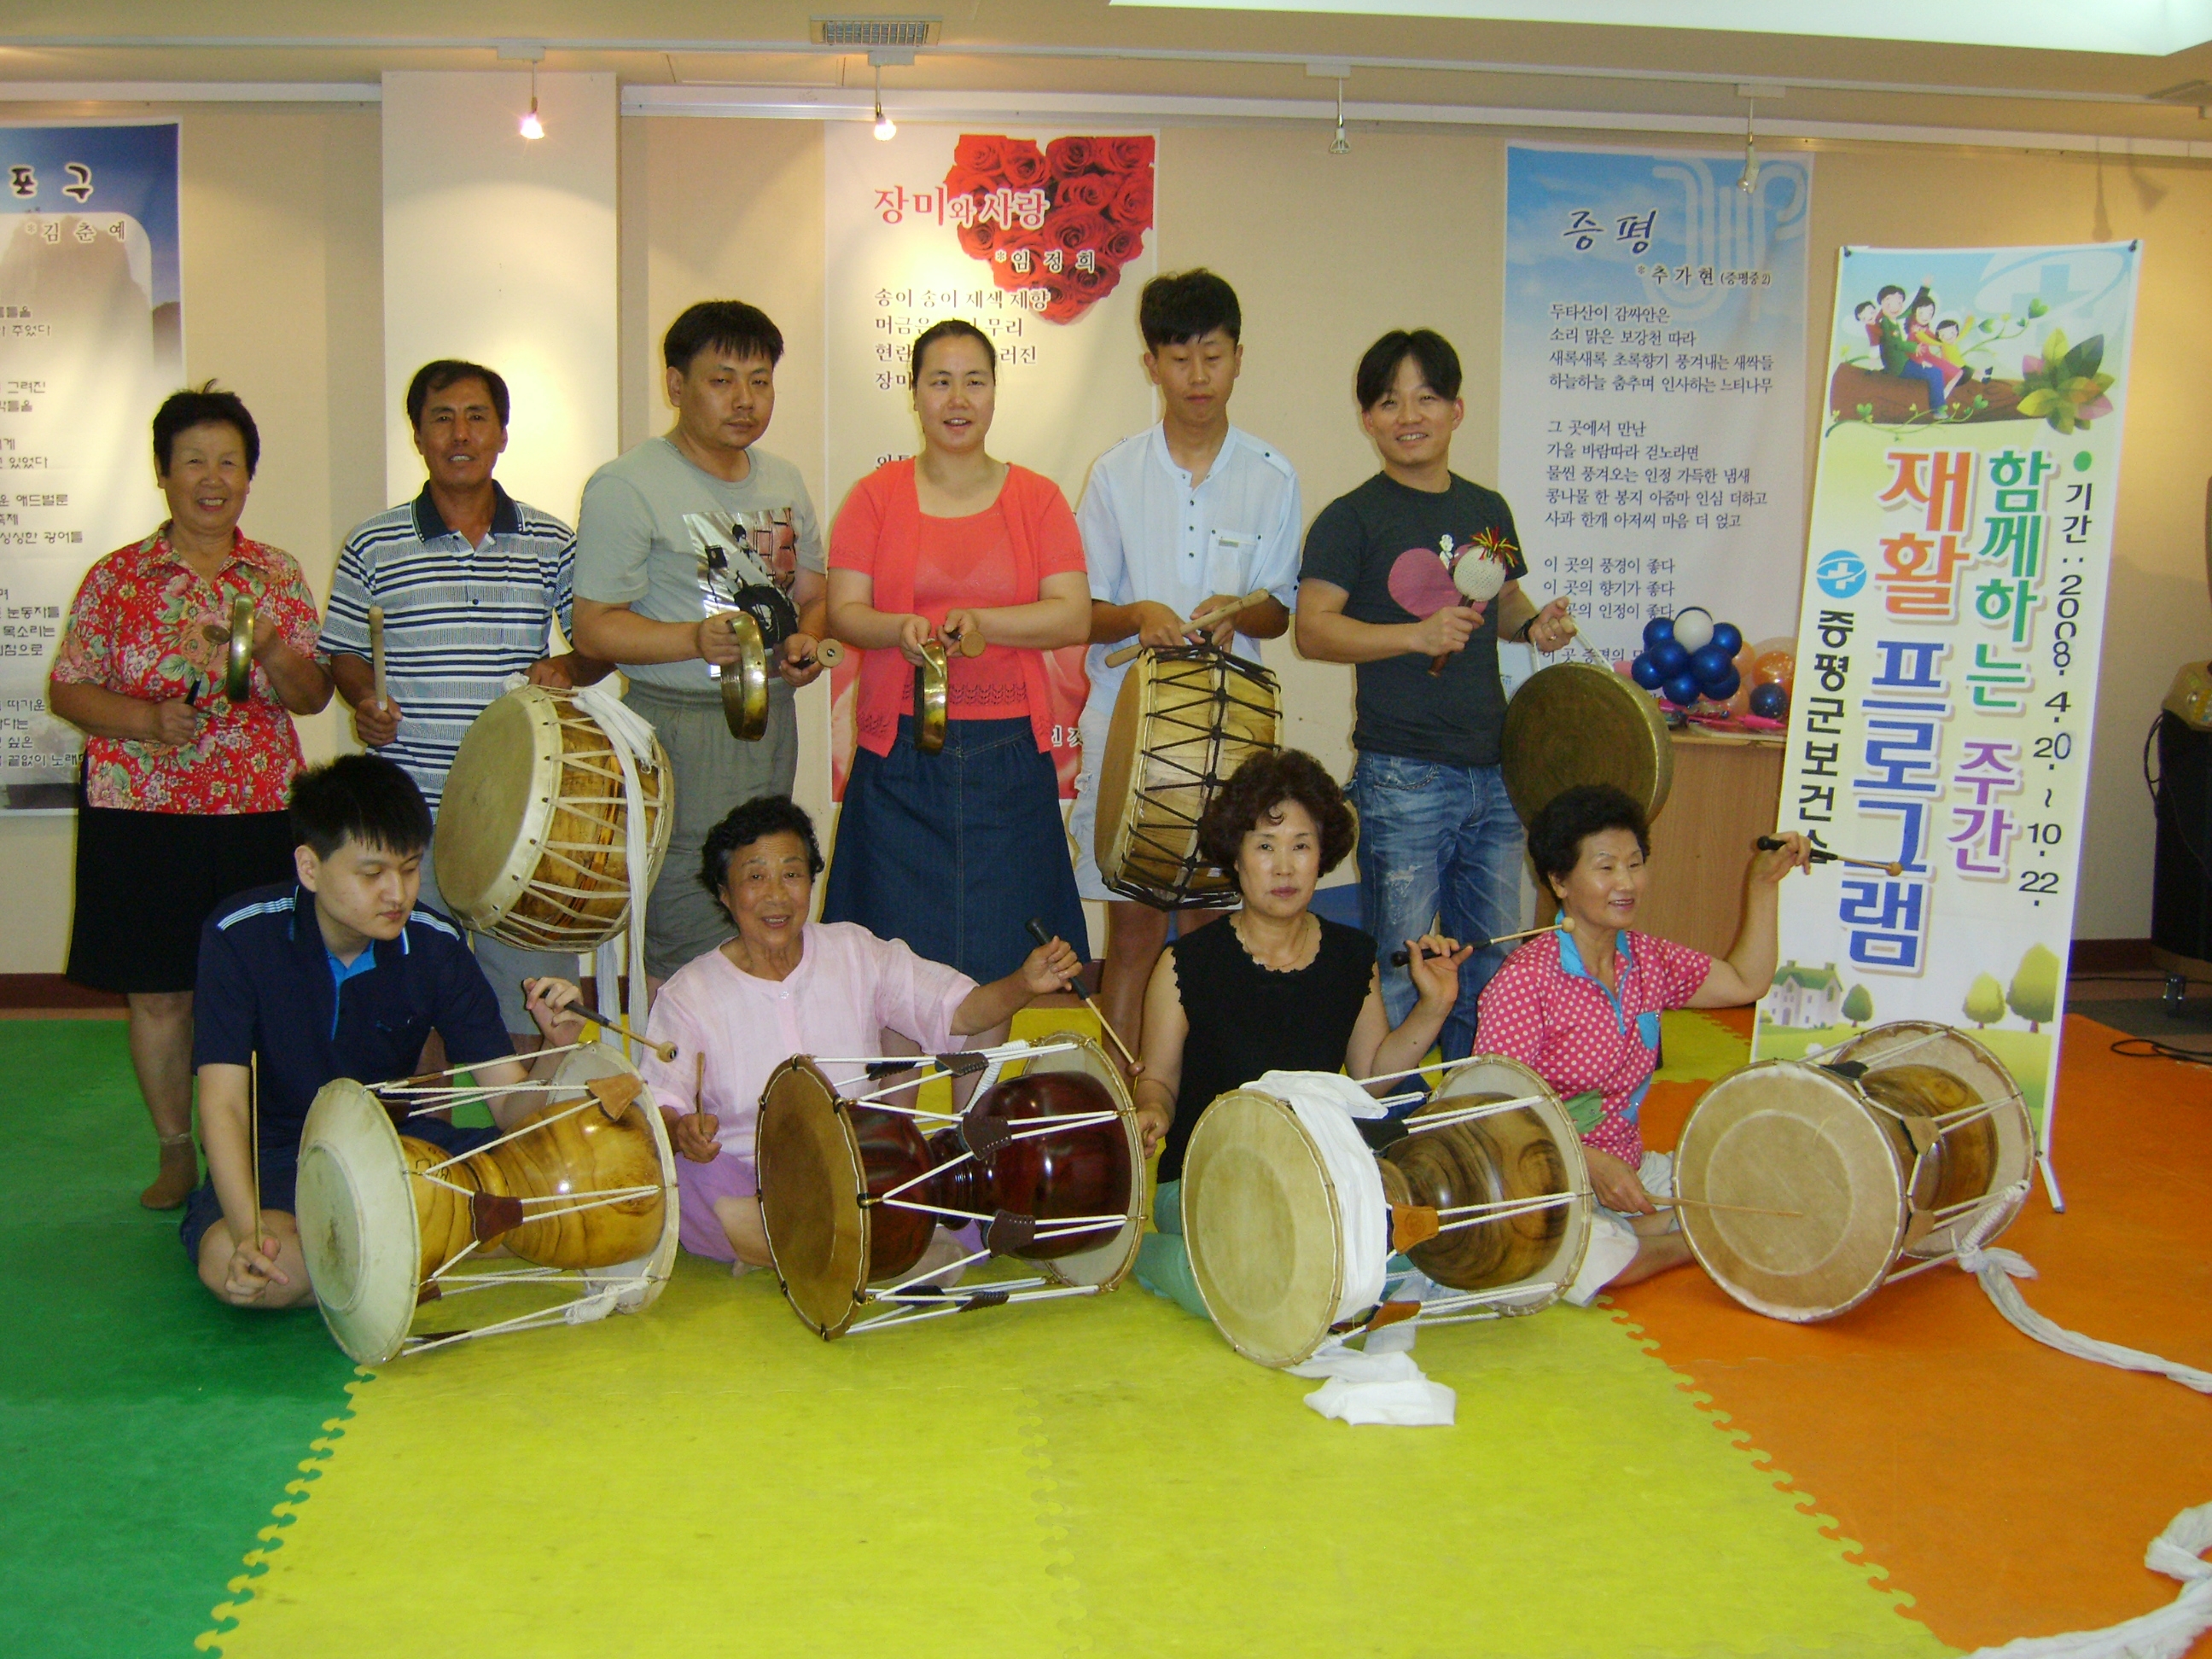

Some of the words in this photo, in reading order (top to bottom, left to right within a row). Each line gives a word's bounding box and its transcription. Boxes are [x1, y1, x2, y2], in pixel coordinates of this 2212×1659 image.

[875, 185, 974, 226] 장미와
[982, 191, 1048, 226] 사랑
[875, 288, 912, 307] 송이
[921, 289, 957, 308] 송이
[1550, 304, 1608, 322] 두타산이
[1614, 306, 1670, 324] 감싸안은
[12, 325, 51, 337] 주었다
[1550, 328, 1579, 344] 소리
[1585, 329, 1615, 345] 맑은
[1621, 329, 1662, 346] 보강천
[1668, 330, 1697, 347] 따라
[999, 346, 1037, 365] 러진
[1613, 352, 1668, 370] 초록향기
[8, 381, 45, 393] 그려진
[1549, 373, 1607, 391] 하늘하늘
[1662, 375, 1715, 393] 인사하는
[1720, 377, 1773, 394] 느티나무
[1547, 421, 1562, 434] 그
[1569, 420, 1610, 437] 곳에서
[1617, 421, 1646, 438] 만난
[1547, 442, 1576, 458] 가을
[1582, 443, 1639, 460] 바람따라
[9, 457, 48, 469] 있었다
[1546, 465, 1575, 481] 물씬
[1581, 466, 1639, 483] 풍겨오는
[1644, 468, 1671, 485] 인정
[1677, 468, 1718, 485] 가득한
[1724, 468, 1749, 485] 냄새
[16, 494, 68, 507] 애드벌룬
[1545, 488, 1589, 505] 콩나물
[1595, 489, 1610, 505] 한
[1615, 489, 1643, 506] 봉지
[1650, 489, 1690, 507] 아줌마
[1697, 491, 1723, 507] 인심
[1731, 491, 1767, 507] 더하고
[1545, 510, 1575, 527] 사과
[1581, 511, 1608, 528] 한개
[1614, 512, 1656, 529] 아저씨
[1662, 512, 1689, 529] 마음
[1697, 513, 1708, 529] 더
[1874, 451, 1971, 616] 재활
[1545, 556, 1557, 573] 이
[1565, 556, 1593, 573] 곳의
[1599, 557, 1640, 574] 풍경이
[1647, 558, 1675, 574] 좋다
[1544, 579, 1557, 596] 이
[1563, 579, 1592, 597] 곳의
[1599, 580, 1641, 597] 향기가
[1647, 580, 1675, 597] 좋다
[1965, 451, 2052, 707] 함께하는
[1599, 602, 1639, 620] 인정이
[3, 626, 55, 637] 목소리는
[9, 736, 32, 748] 싶은
[1839, 640, 1947, 968] 프로그램
[1947, 742, 2016, 873] 주간
